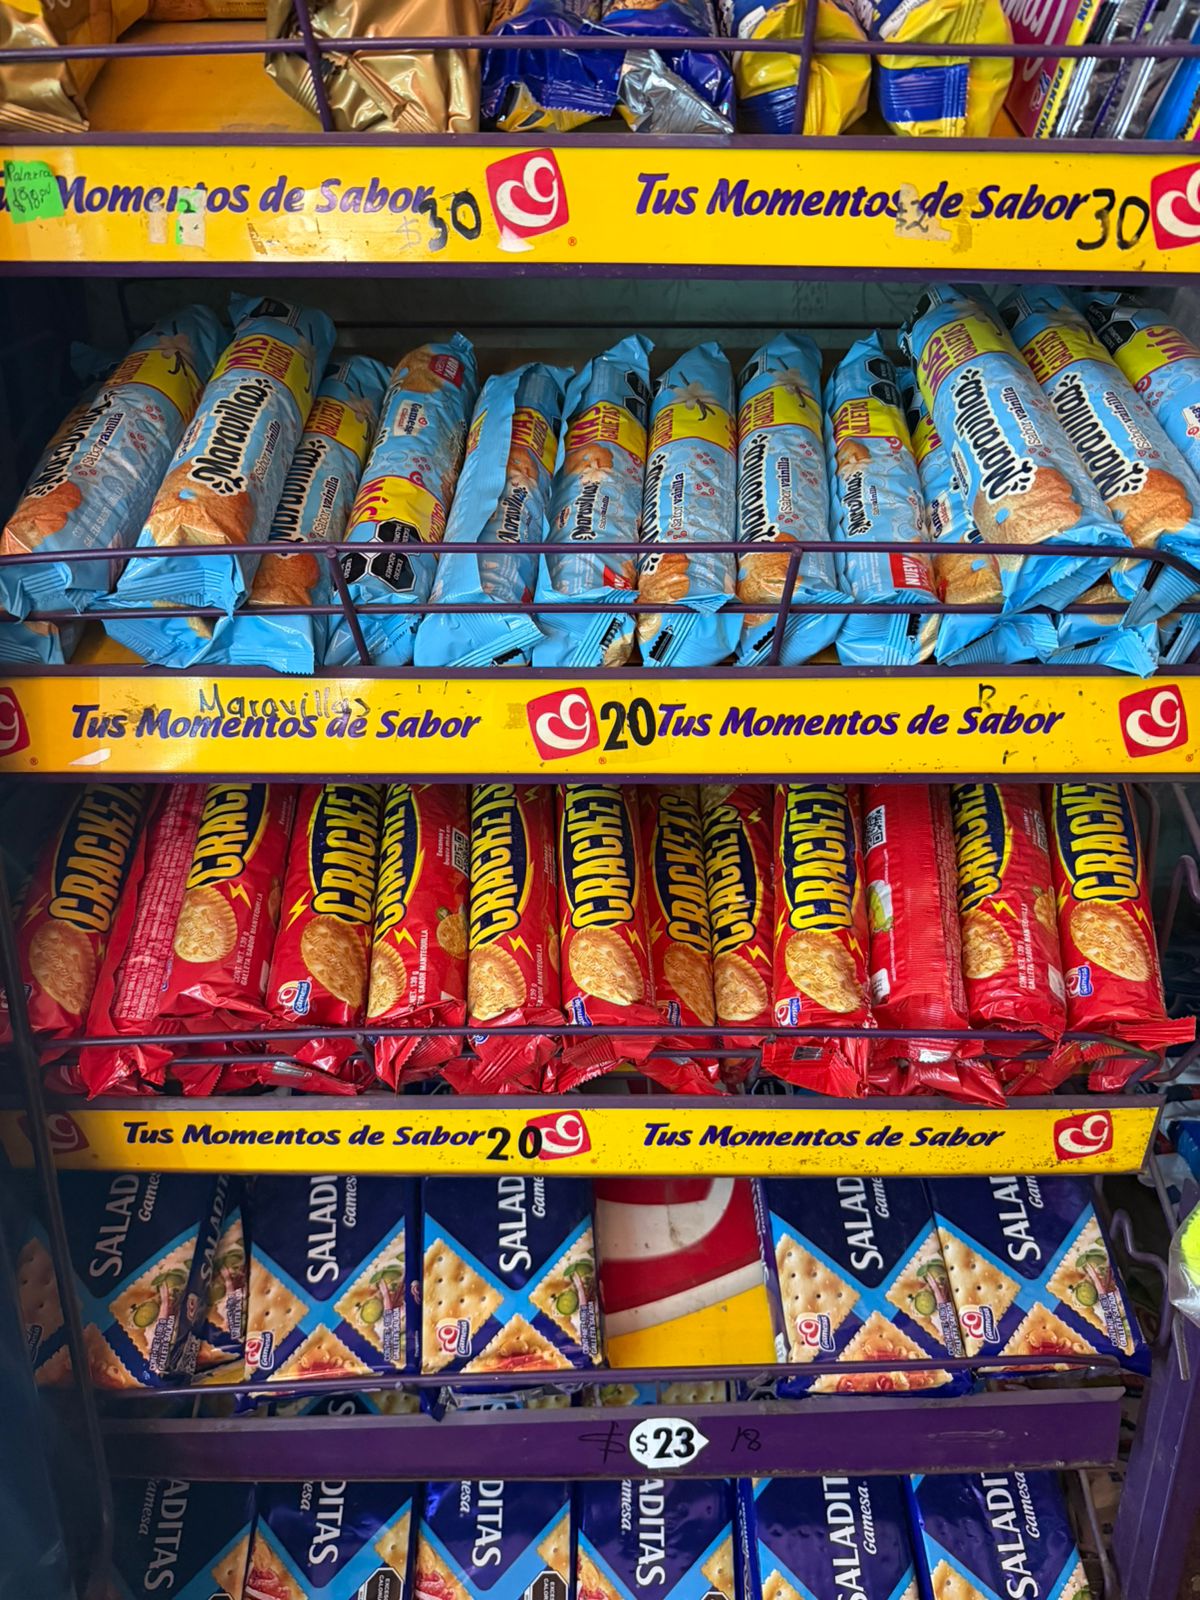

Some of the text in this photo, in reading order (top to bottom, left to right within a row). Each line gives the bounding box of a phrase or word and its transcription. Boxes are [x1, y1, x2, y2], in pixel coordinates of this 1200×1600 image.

[58, 175, 249, 214] Momeos
[273, 176, 304, 212] de
[316, 178, 436, 213] Sabor
[636, 172, 698, 216] Tus
[707, 178, 901, 217] Momentos
[918, 180, 964, 218] de
[971, 184, 1088, 220] Sabor
[418, 190, 482, 252] 30
[1076, 188, 1150, 251] 30
[1003, 387, 1028, 421] vainilla
[192, 381, 274, 491] Maravillas
[265, 421, 281, 454] vainilla
[954, 379, 1033, 500] Maravillas
[1053, 385, 1144, 500] Maravillas
[671, 472, 684, 505] vainilla
[778, 457, 792, 487] vainilla
[322, 476, 339, 509] vainilla
[199, 683, 371, 719] Maravillas
[72, 705, 482, 739] Tus Momentos de Sabor
[600, 697, 656, 751] 20
[657, 704, 1064, 737] Tus Momentos de Sabor
[186, 783, 253, 889] CRAC
[418, 930, 428, 997] SABOR MANTEQUILLA
[123, 1121, 486, 1147] Tus Momentos de Sabor
[486, 1125, 543, 1161] 20
[644, 1122, 1005, 1147] Tus Momentos de Sabor
[498, 1177, 532, 1272] SALAD
[836, 1177, 884, 1270] SALAD
[163, 1315, 175, 1345] SALADA
[393, 1308, 401, 1333] SALADA
[457, 1320, 470, 1355] Gamesa
[588, 1301, 599, 1355] GALLETA SALADA
[819, 1315, 834, 1352] Gamesa
[983, 1306, 997, 1341] Gamesa
[1108, 1292, 1127, 1347] GALLETA SALADA
[260, 1332, 273, 1366] Gamesa
[635, 1426, 696, 1460] $23
[472, 1480, 504, 1568] DITAS
[858, 1485, 878, 1556] Gamesa
